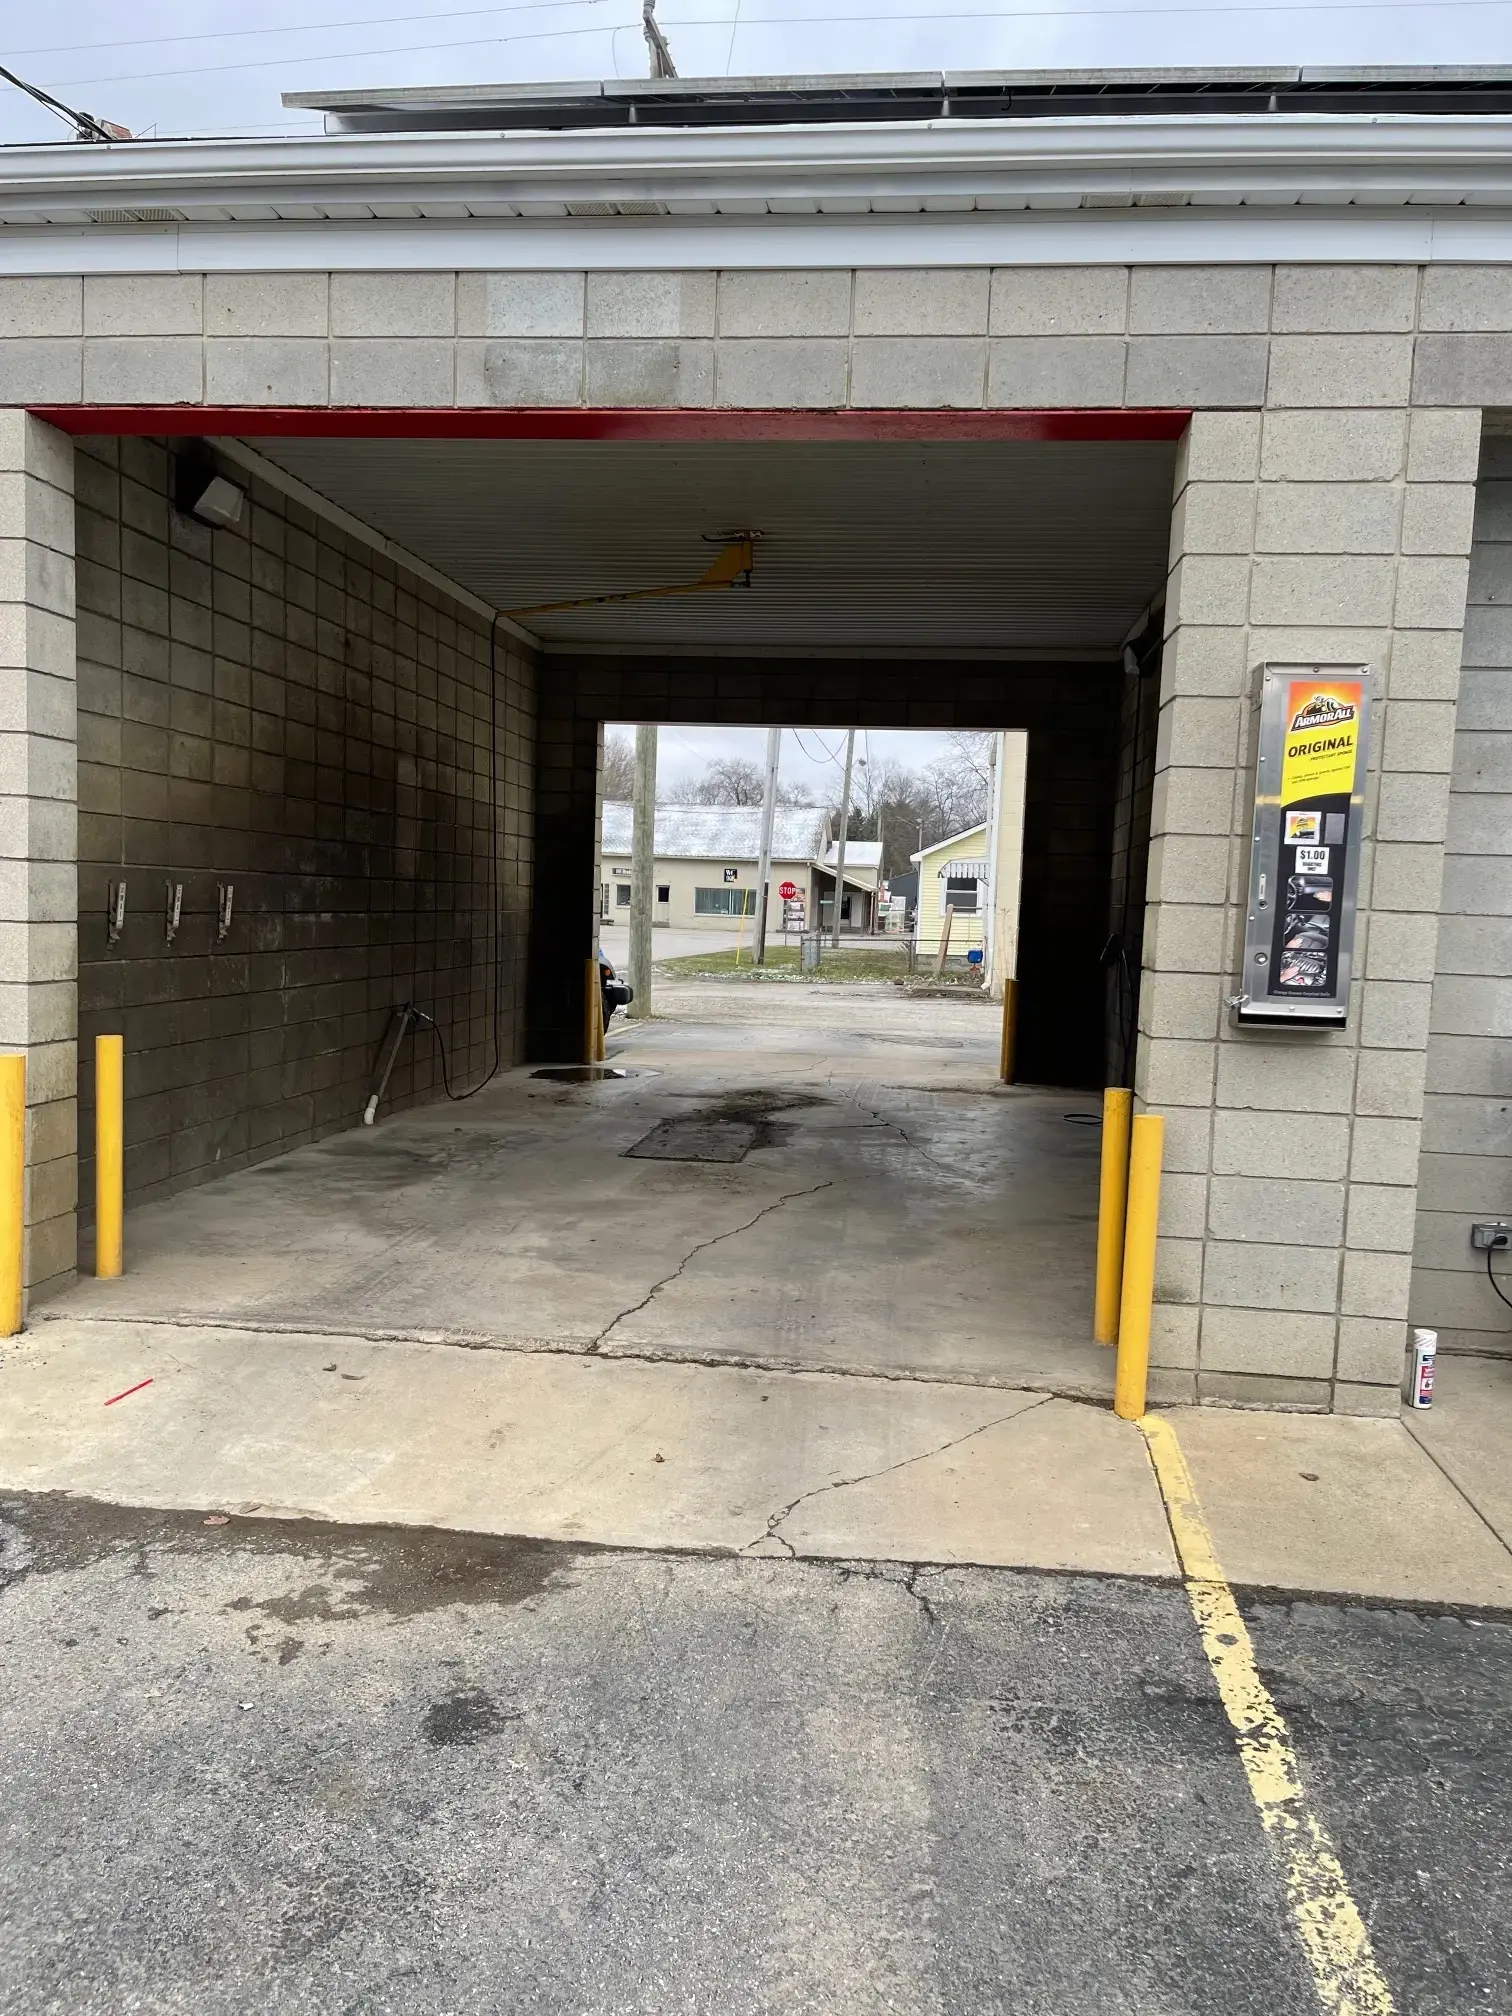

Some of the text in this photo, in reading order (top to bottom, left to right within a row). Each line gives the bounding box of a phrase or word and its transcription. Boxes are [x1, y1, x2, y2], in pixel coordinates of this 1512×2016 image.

[1288, 735, 1353, 758] ORIGINAL
[1300, 849, 1326, 860] $1.00
[779, 886, 797, 895] STOP
